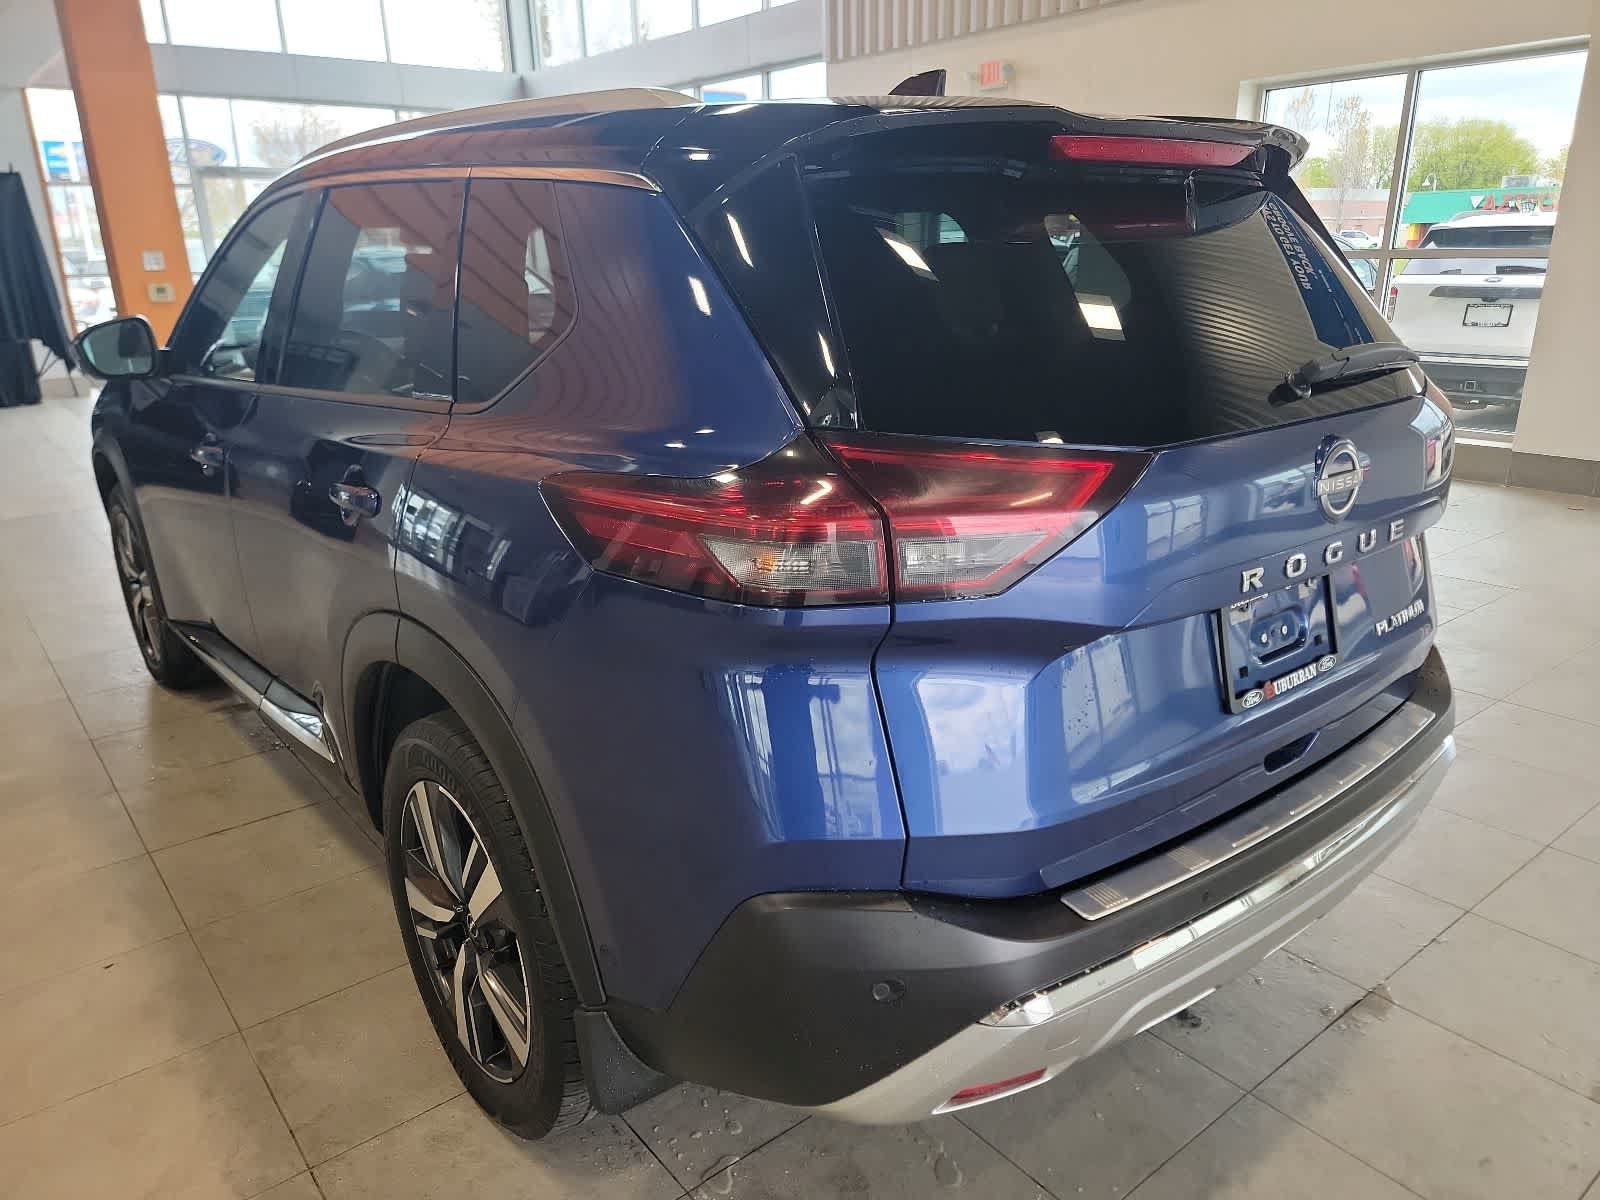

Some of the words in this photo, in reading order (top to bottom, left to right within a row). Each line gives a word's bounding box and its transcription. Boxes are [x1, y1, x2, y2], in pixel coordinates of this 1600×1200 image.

[1319, 470, 1362, 492] NISSA
[1242, 519, 1405, 593] ROGUE
[1375, 599, 1425, 637] PLATINUM
